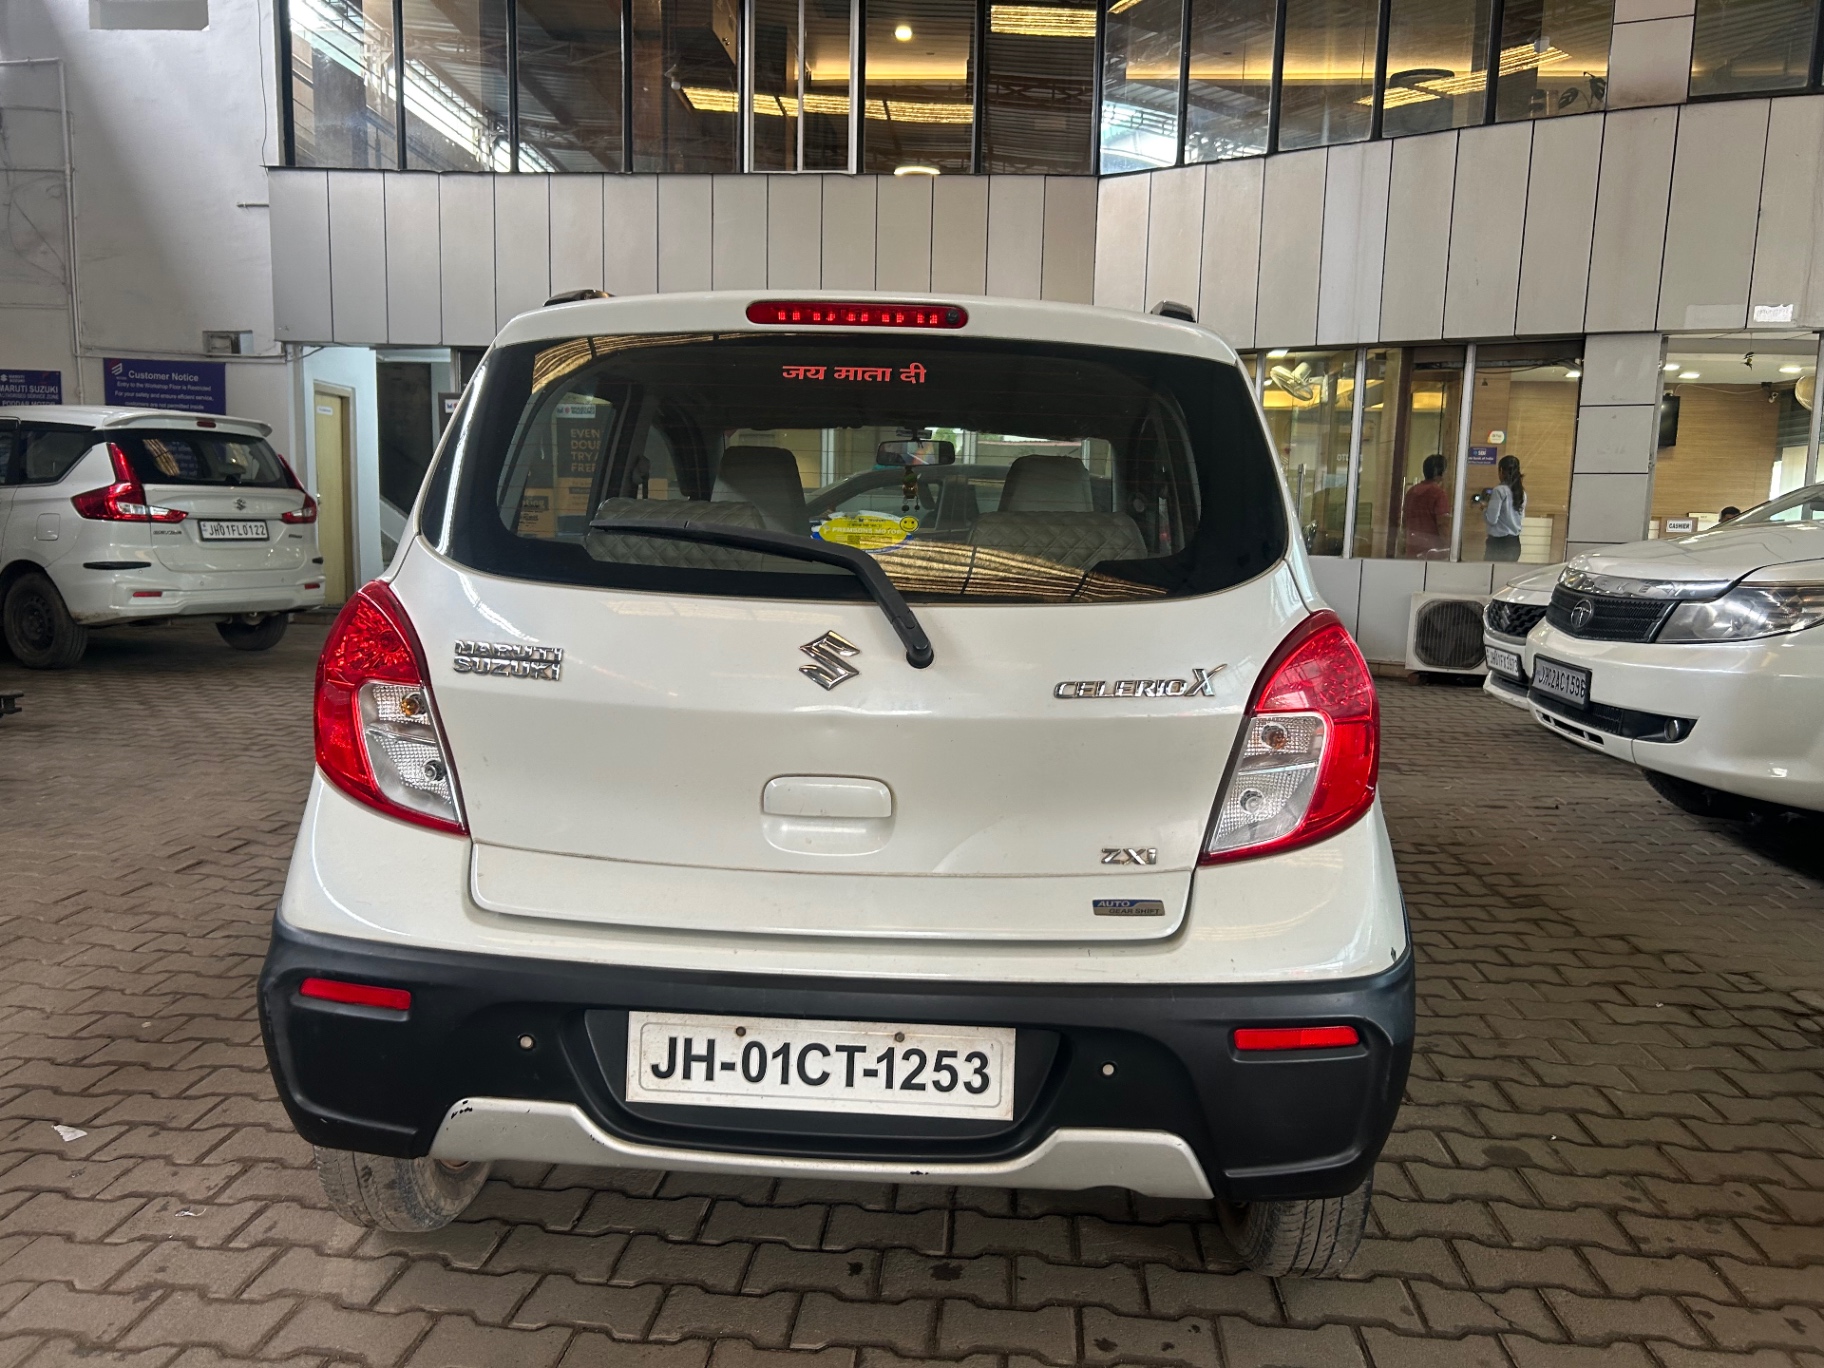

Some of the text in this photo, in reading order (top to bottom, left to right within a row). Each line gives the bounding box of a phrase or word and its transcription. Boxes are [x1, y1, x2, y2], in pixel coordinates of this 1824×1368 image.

[128, 370, 199, 382] Customer Notice
[782, 362, 927, 384] जय माता दी
[0, 384, 59, 394] MARUTI SUZUKI
[209, 523, 266, 537] JH01FL0122
[454, 640, 563, 662] MARUTI
[453, 655, 562, 681] SUZUKI
[650, 1036, 990, 1094] JH-01CT-1253
